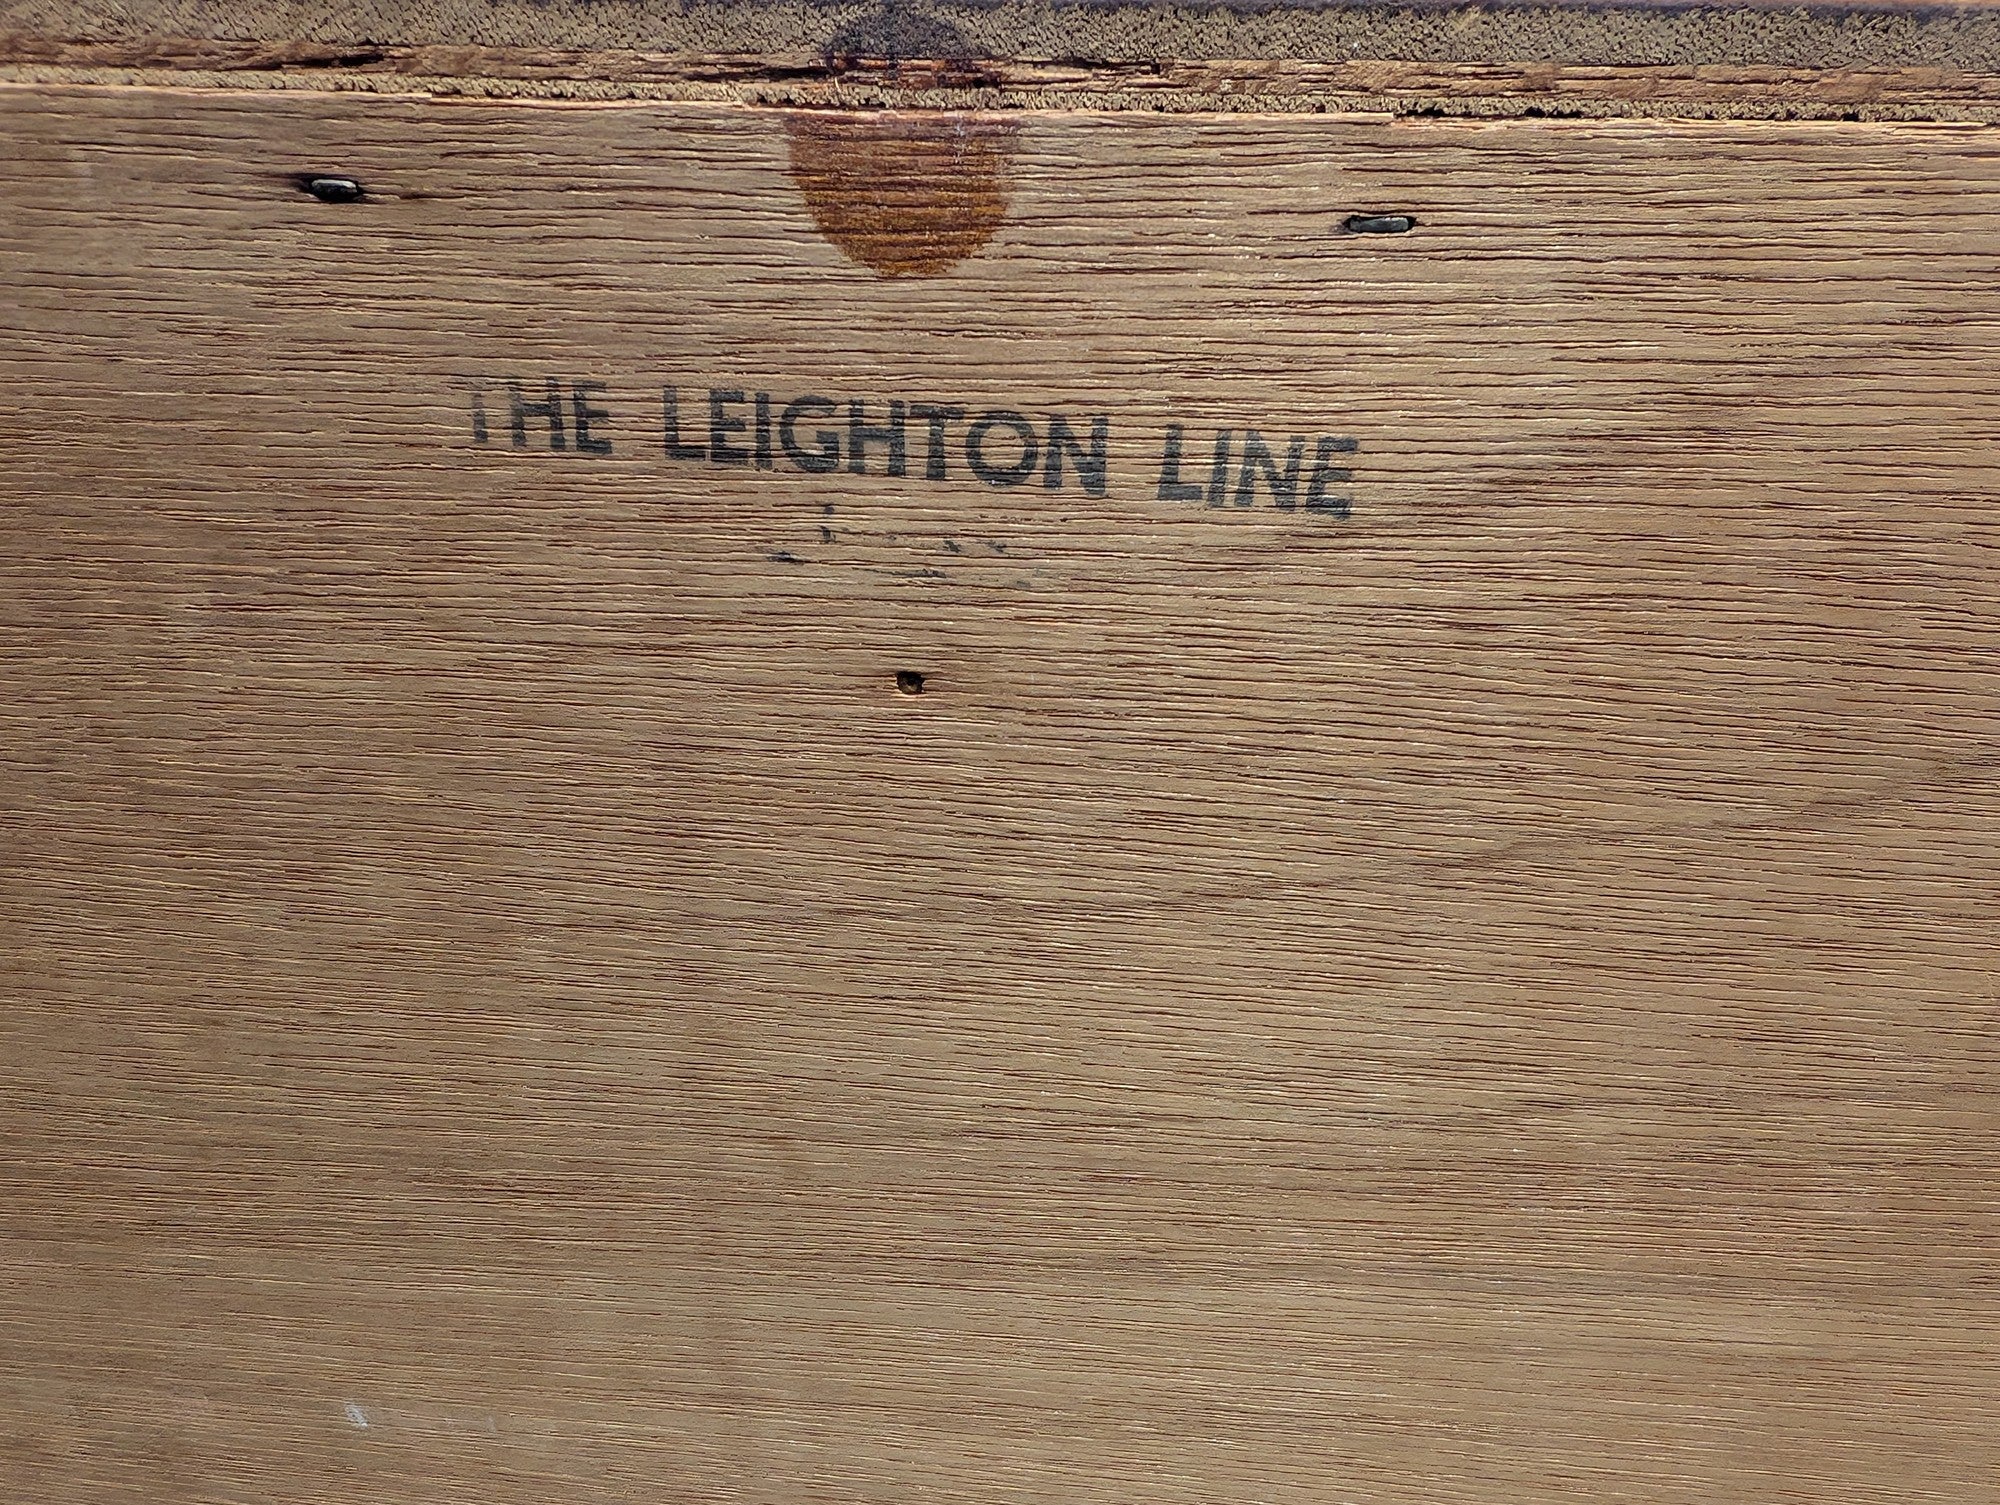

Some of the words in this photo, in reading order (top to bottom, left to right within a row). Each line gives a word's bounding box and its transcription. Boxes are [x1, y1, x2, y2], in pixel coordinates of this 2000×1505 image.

[456, 375, 613, 455] THE
[663, 384, 1109, 497] LEIGHTON
[1157, 423, 1359, 519] LINE
